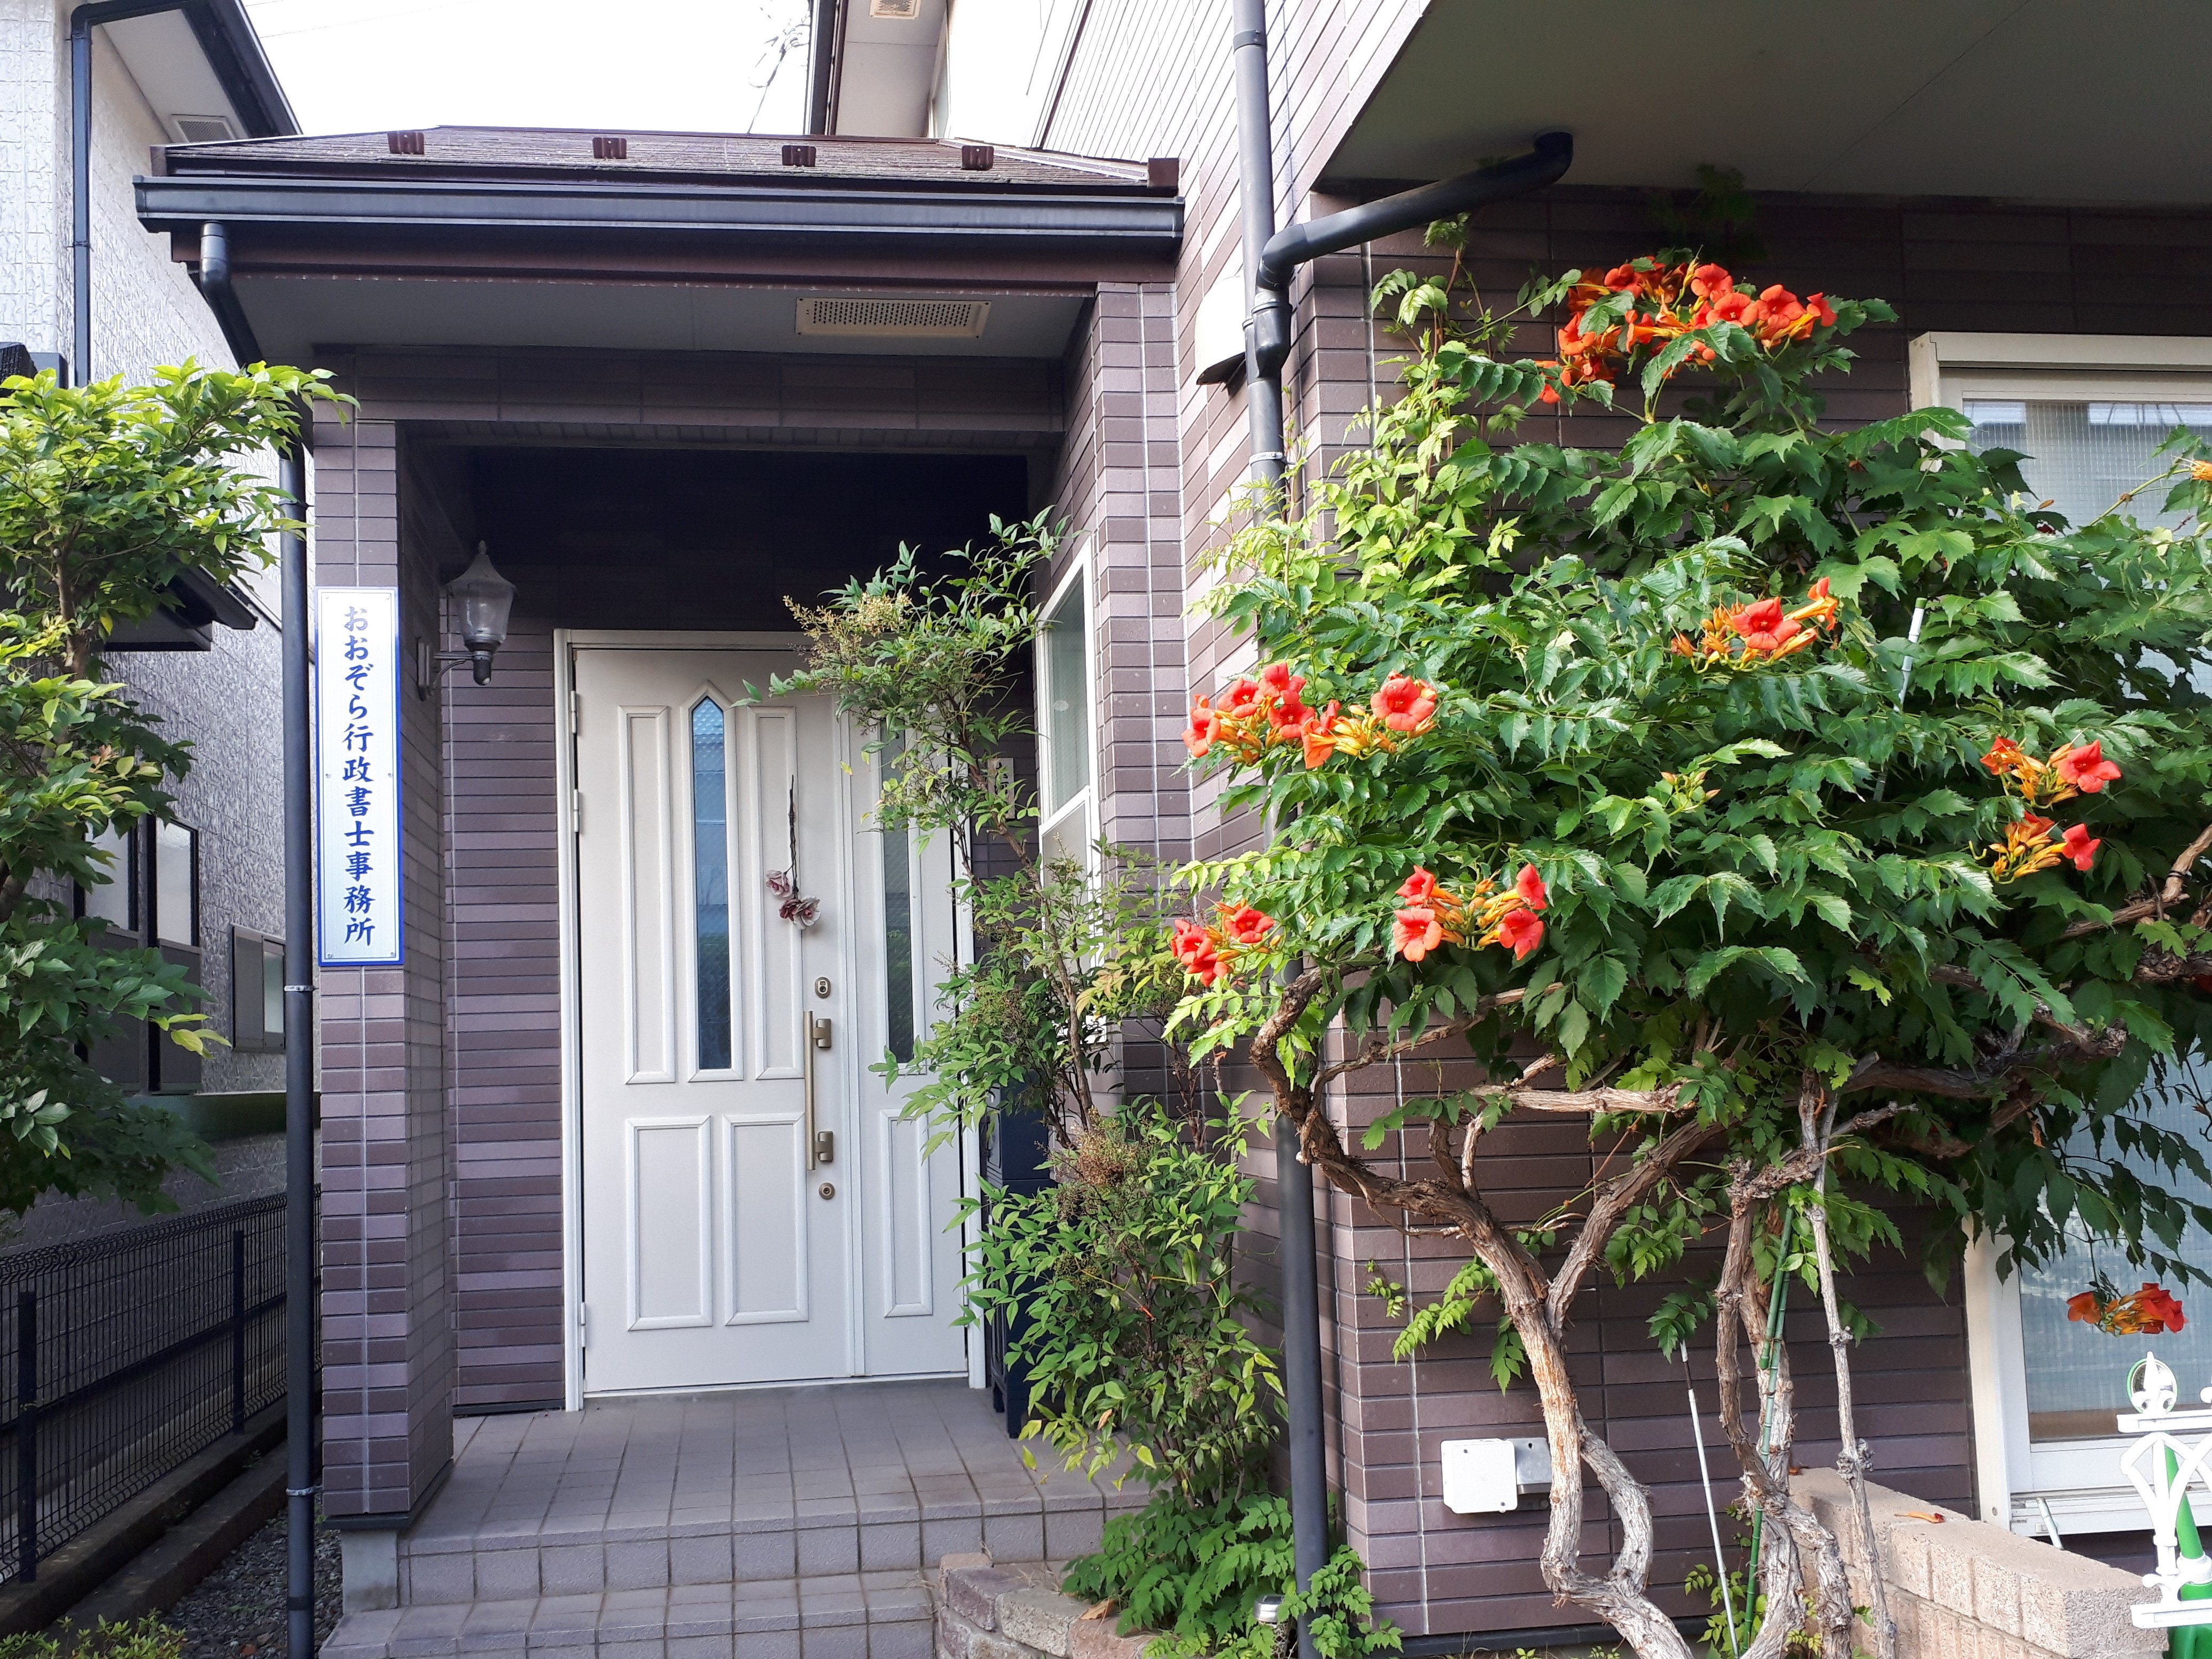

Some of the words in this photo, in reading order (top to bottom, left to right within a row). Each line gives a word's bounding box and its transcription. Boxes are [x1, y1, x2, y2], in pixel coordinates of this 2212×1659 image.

[342, 605, 376, 946] おおぞら行政書士事務所
